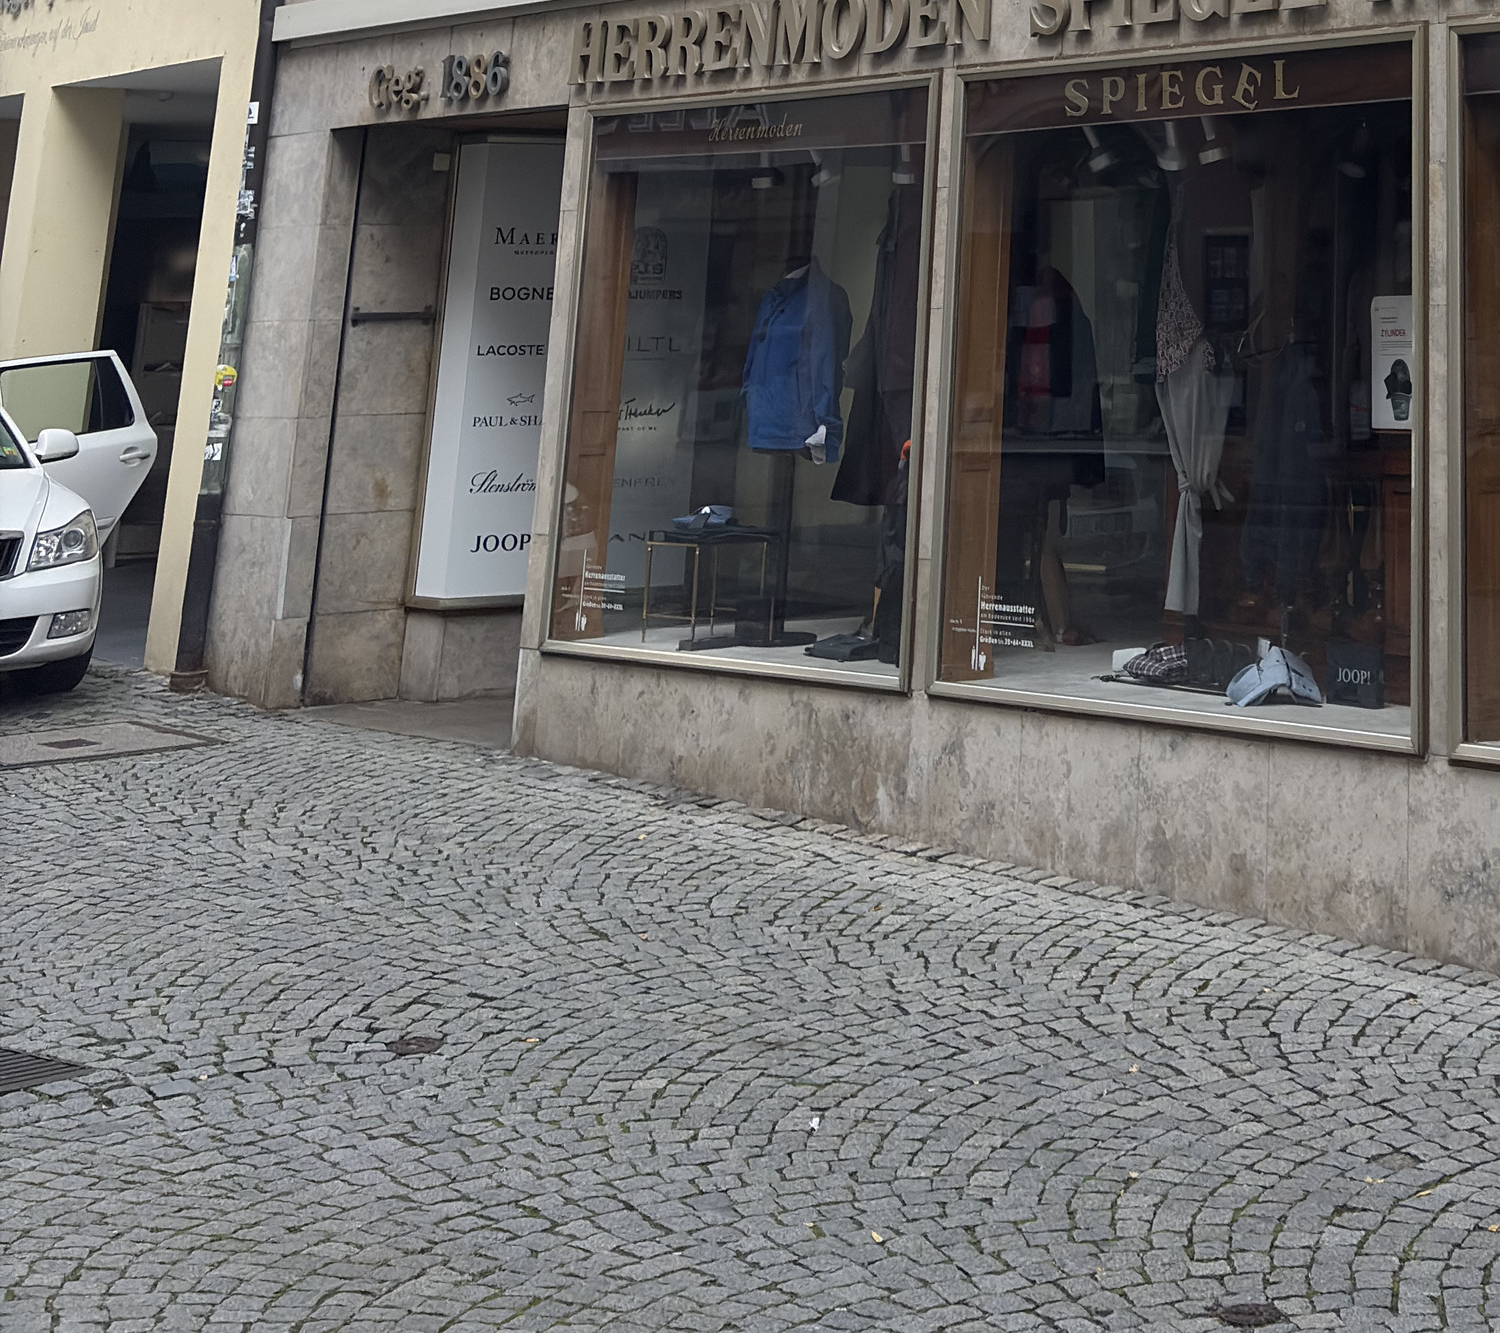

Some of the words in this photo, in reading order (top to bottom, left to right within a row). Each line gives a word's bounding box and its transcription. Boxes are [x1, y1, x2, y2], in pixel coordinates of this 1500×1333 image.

[440, 51, 511, 101] 1886
[1064, 60, 1300, 118] SPIEGEL
[708, 113, 803, 142] Herrenmoden
[494, 227, 558, 245] MAER
[489, 286, 554, 301] BOGNE
[477, 344, 545, 357] LACOSTE
[627, 337, 681, 352] ILTL
[981, 601, 1035, 614] Herrenausstatter
[1336, 667, 1371, 686] JOOP!
